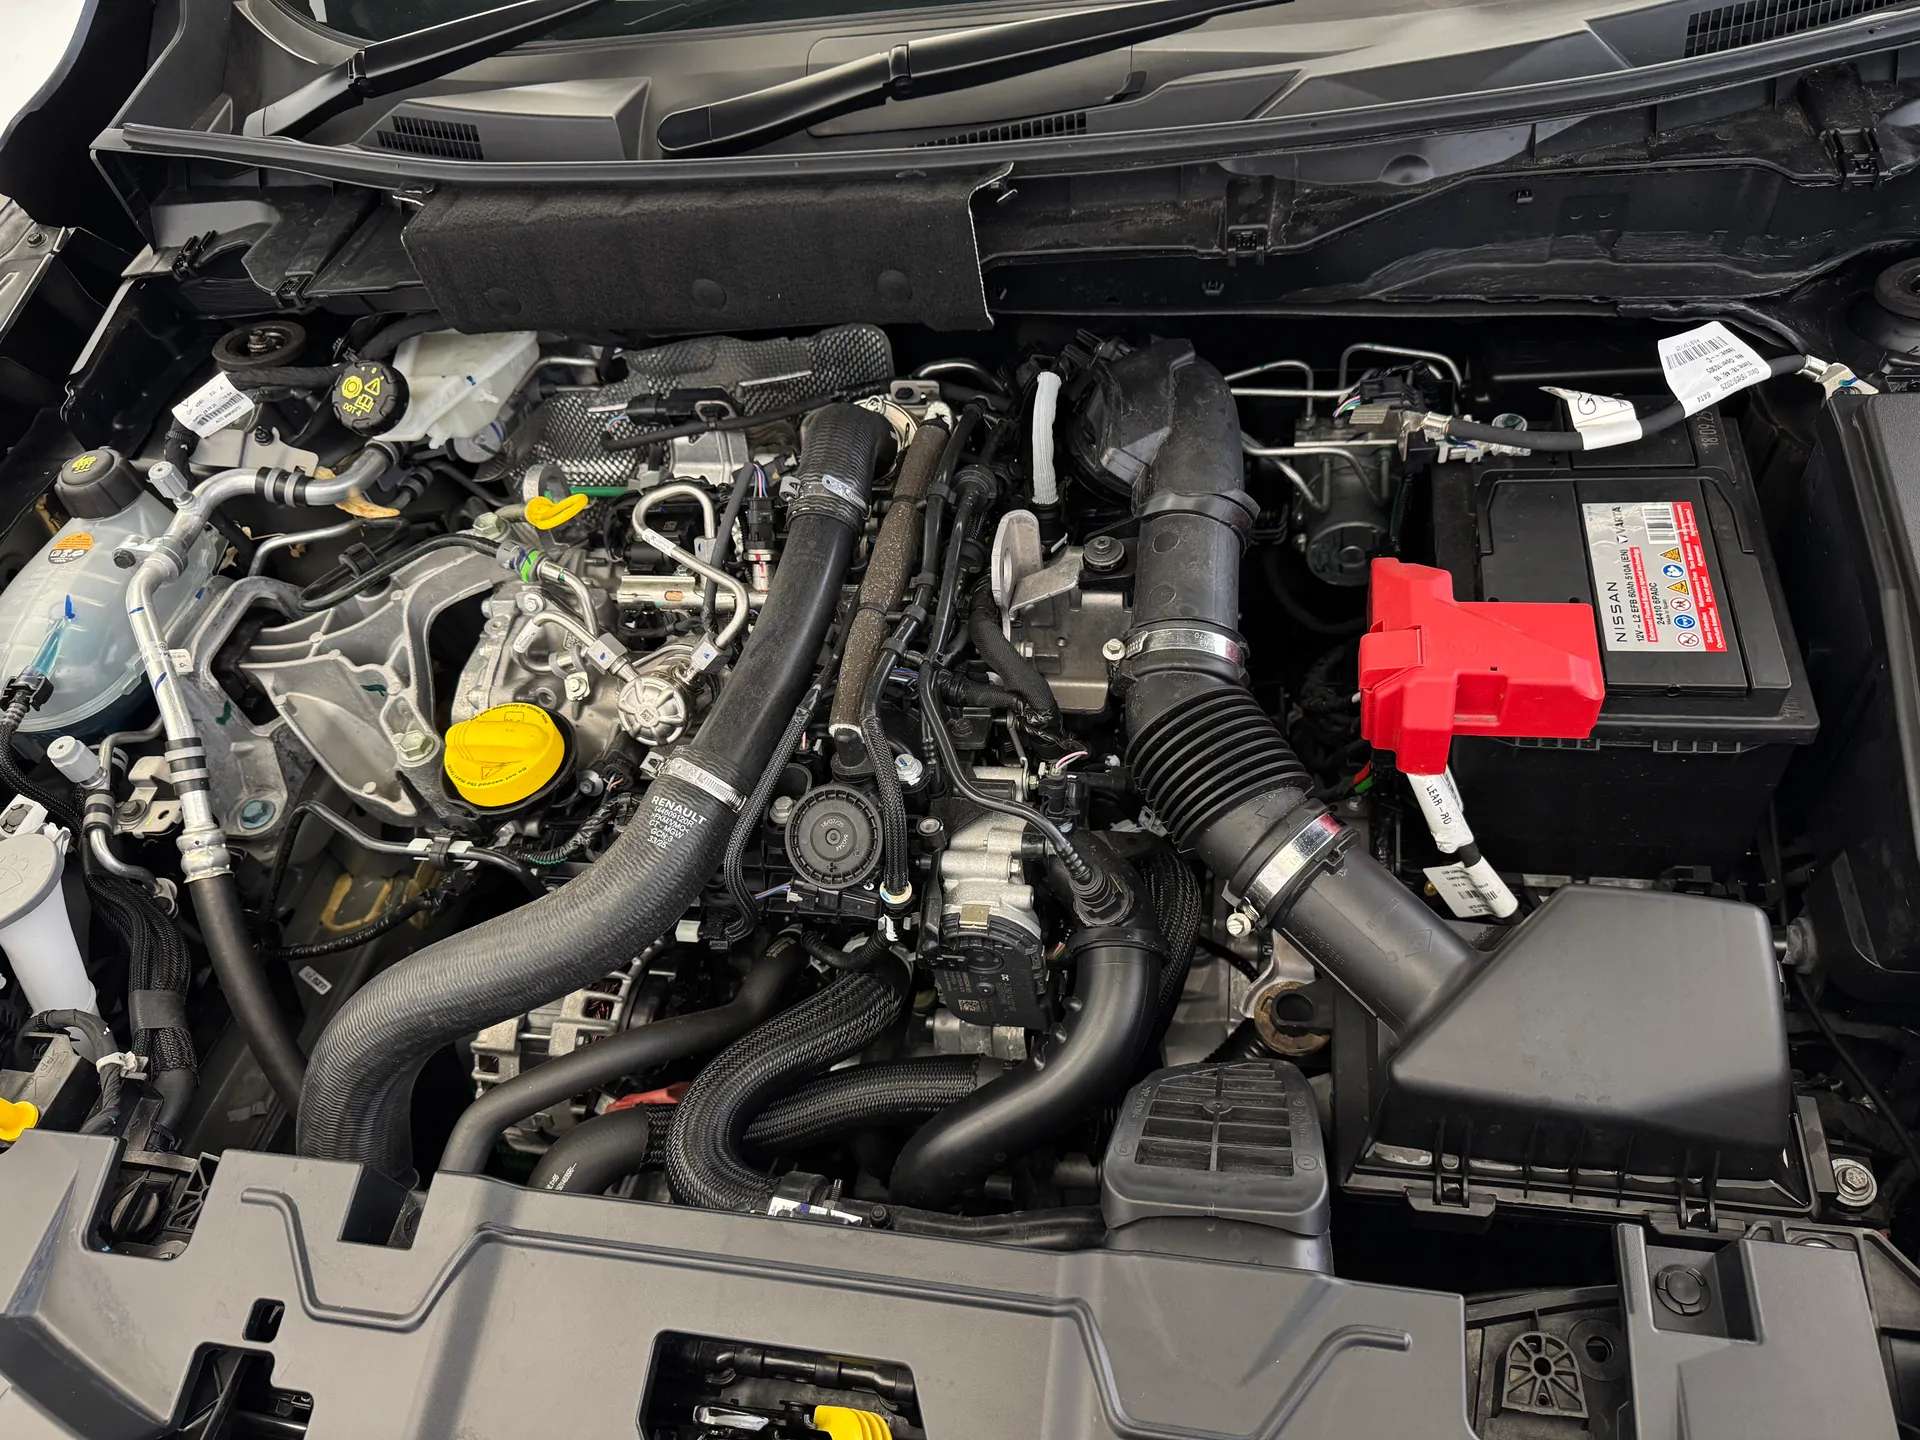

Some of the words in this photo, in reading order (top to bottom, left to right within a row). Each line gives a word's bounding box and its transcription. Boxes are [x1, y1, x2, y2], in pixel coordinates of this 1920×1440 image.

[1612, 506, 1626, 533] VARTA
[1620, 549, 1630, 562] (EN)
[1623, 563, 1633, 580] 510A
[1627, 581, 1636, 597] 60Ah
[1606, 581, 1628, 642] NISSAN
[1630, 599, 1639, 612] EFB
[1633, 614, 1641, 622] L2
[1654, 605, 1665, 624] 24410
[1636, 629, 1645, 641] 12V
[651, 795, 708, 825] RENAULT
